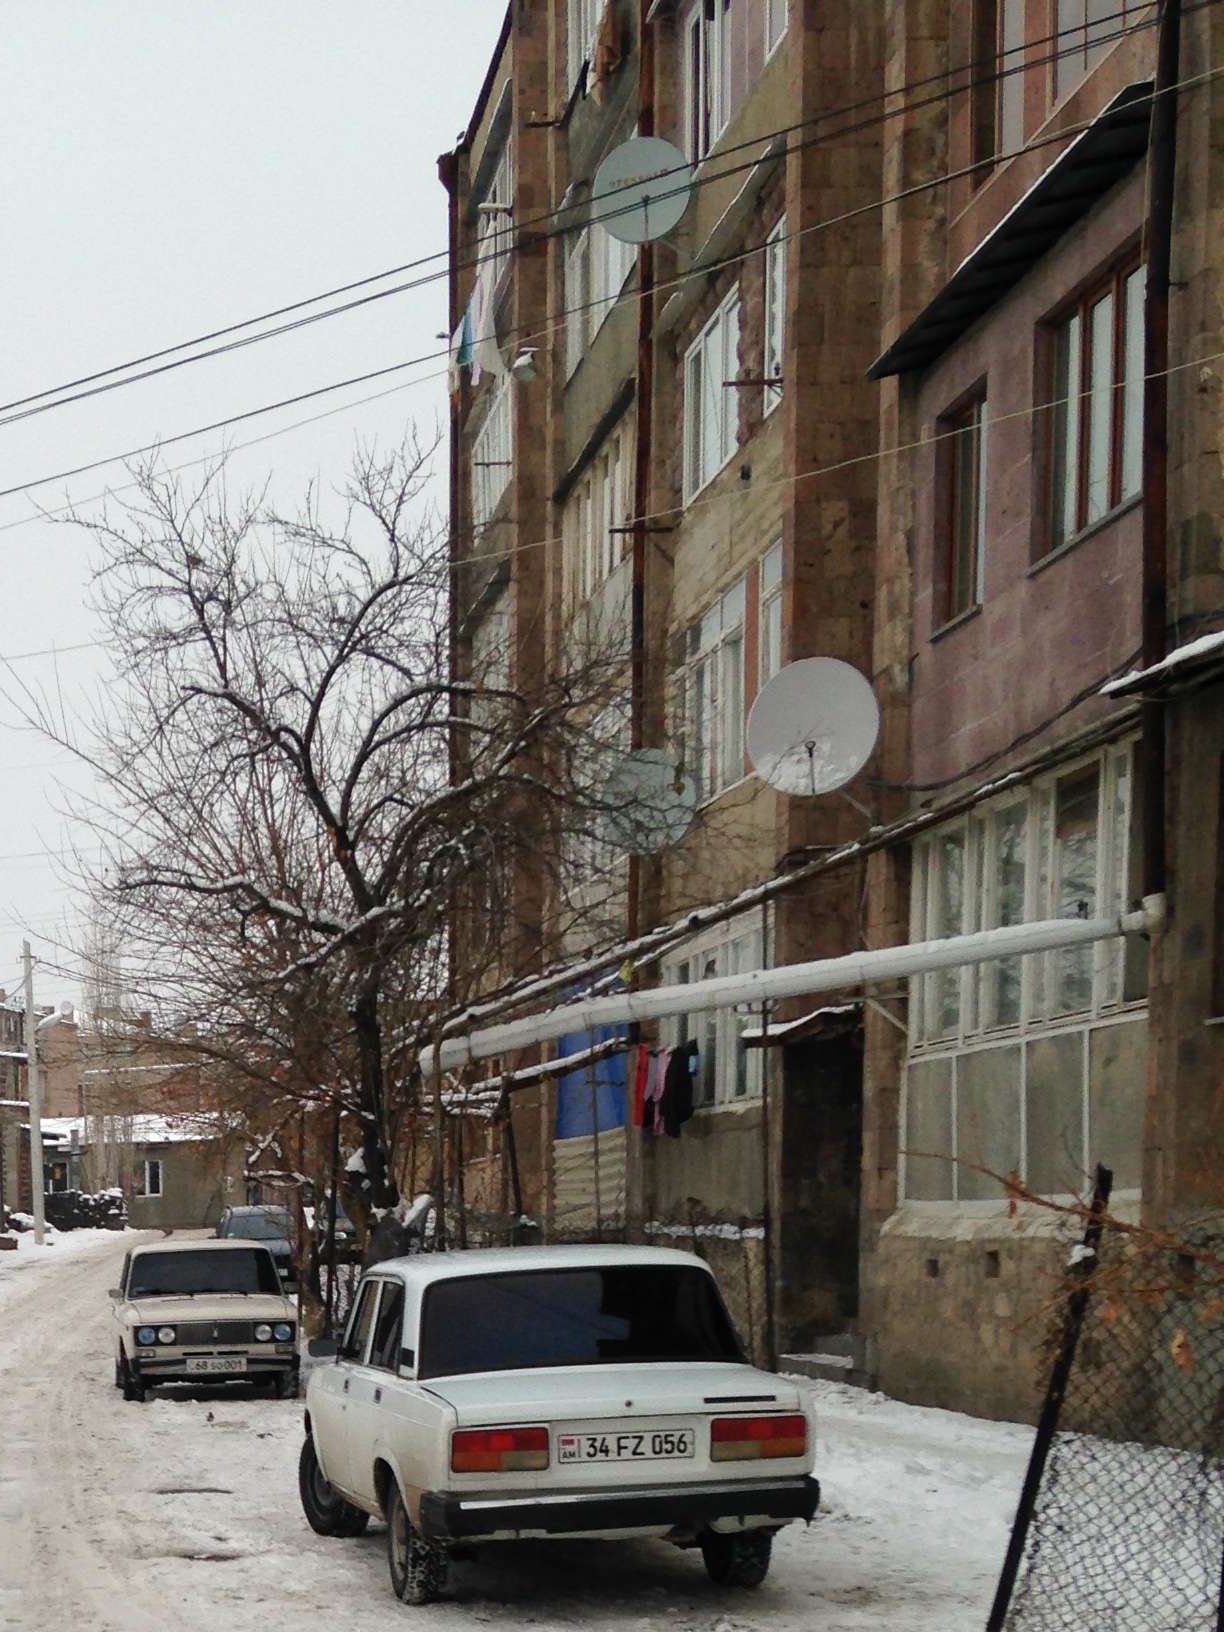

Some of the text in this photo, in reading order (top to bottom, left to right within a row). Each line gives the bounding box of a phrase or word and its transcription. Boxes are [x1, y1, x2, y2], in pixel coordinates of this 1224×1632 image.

[195, 1360, 207, 1371] 68
[586, 1433, 688, 1458] 34 FZ 056
[562, 1450, 576, 1459] AM
